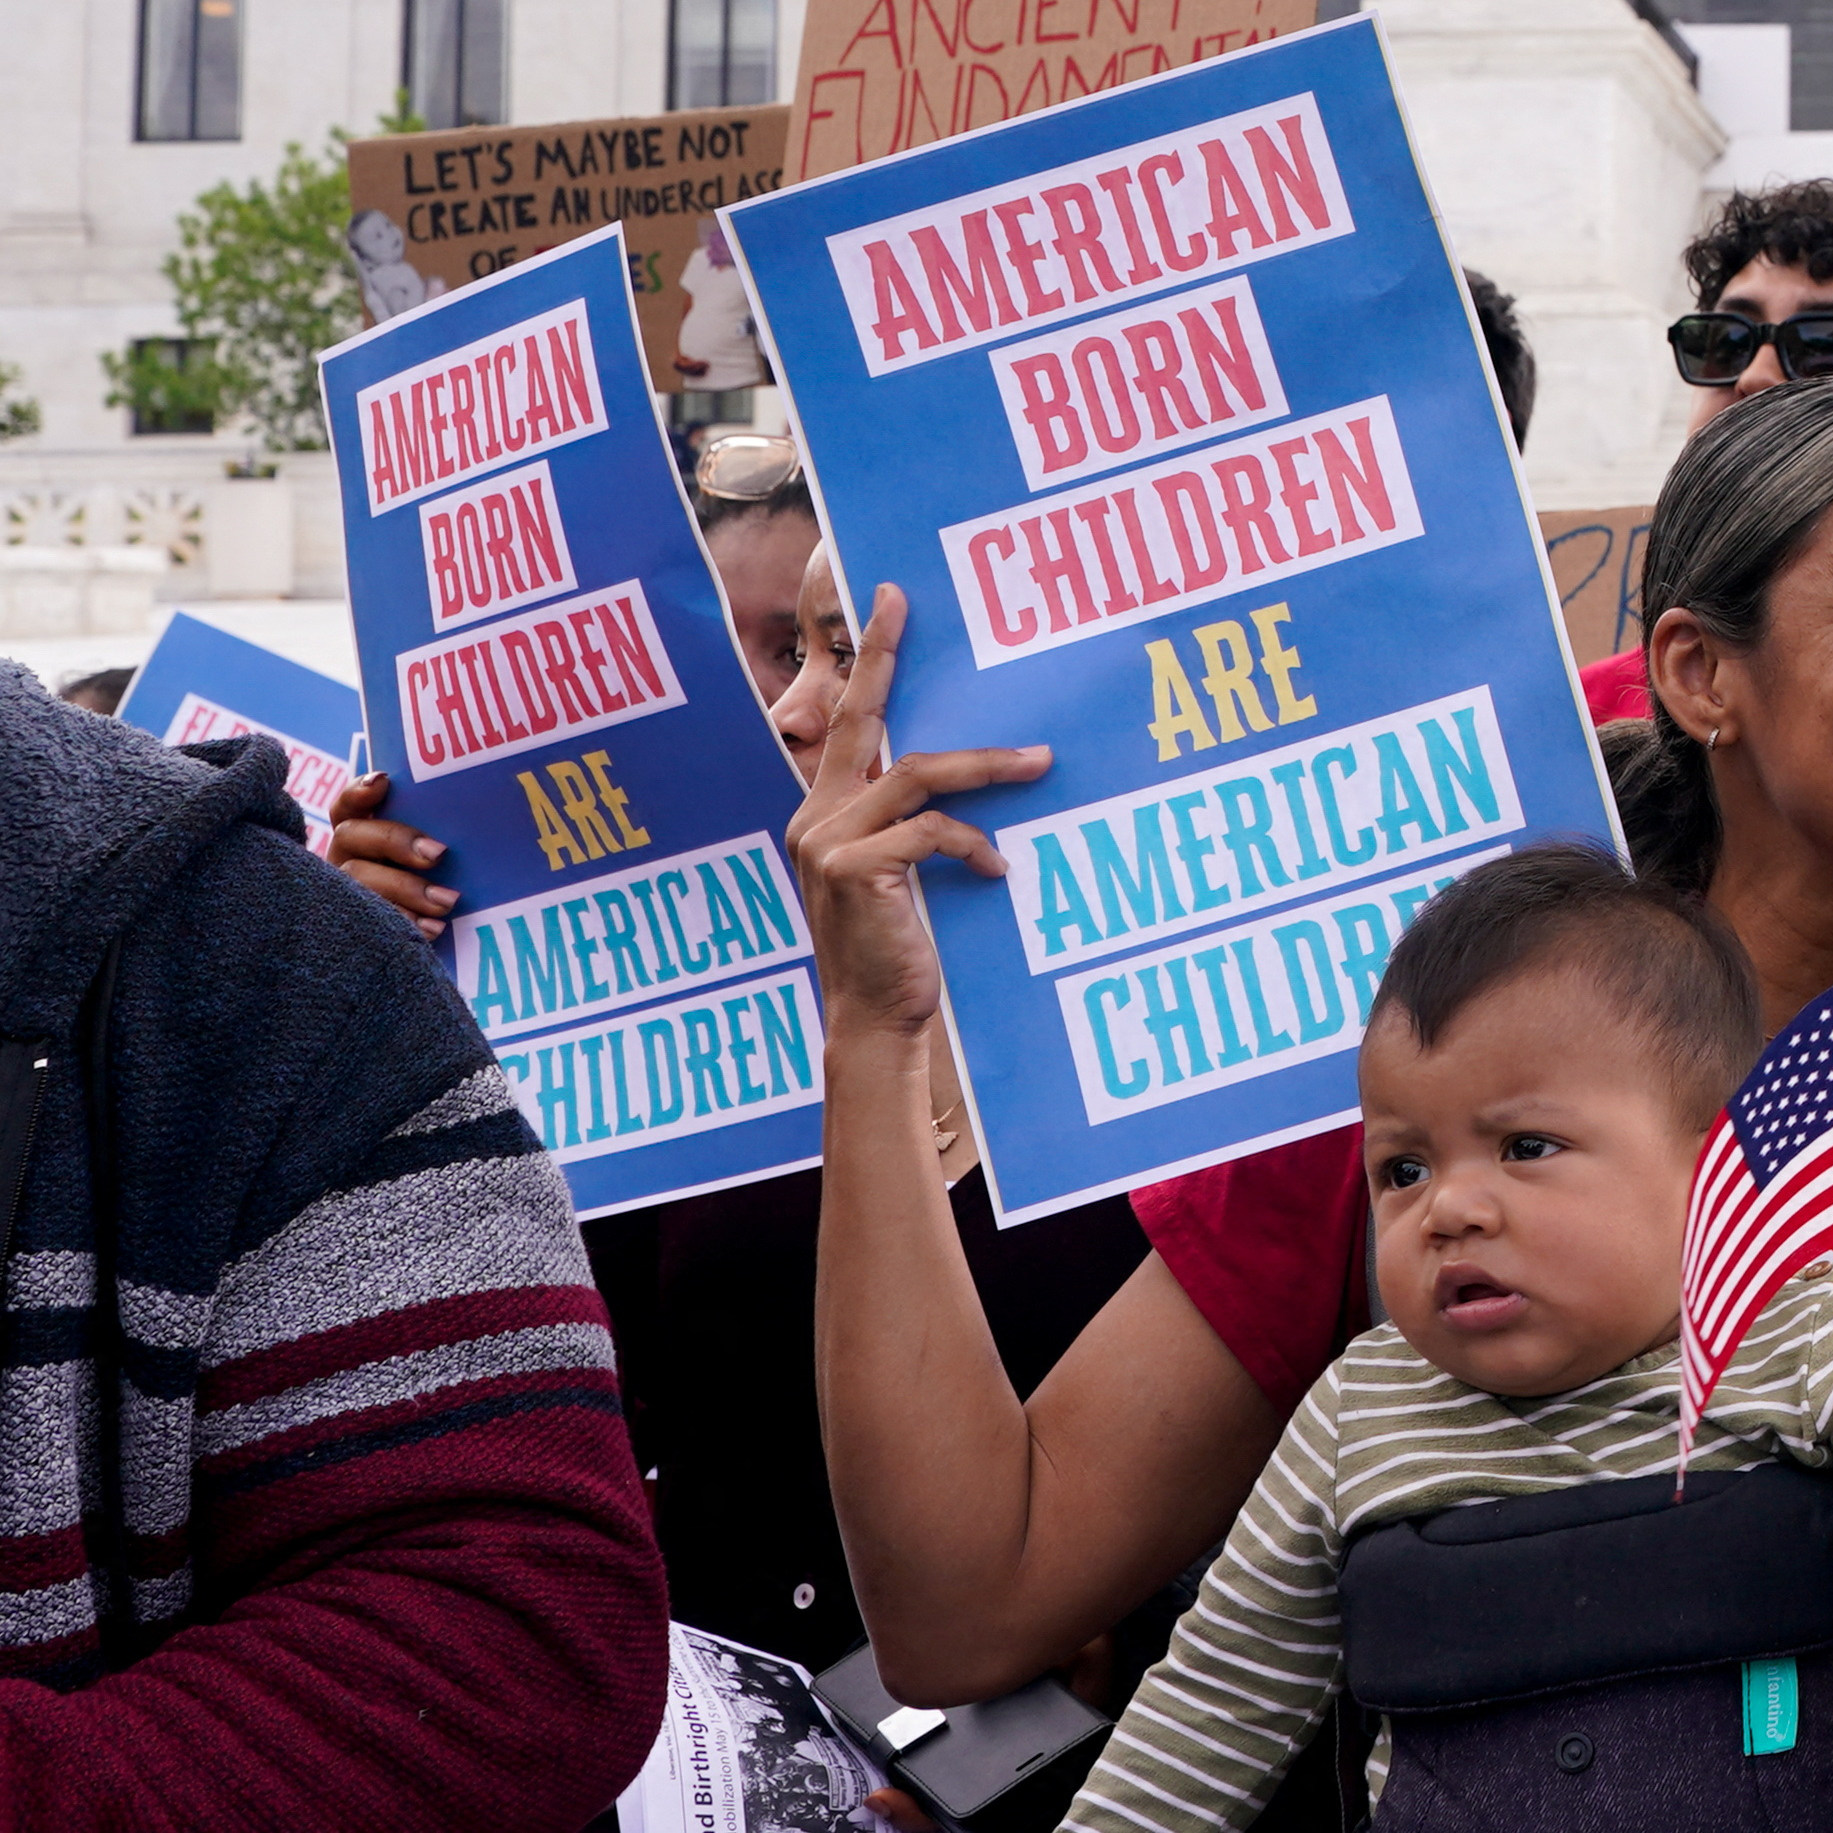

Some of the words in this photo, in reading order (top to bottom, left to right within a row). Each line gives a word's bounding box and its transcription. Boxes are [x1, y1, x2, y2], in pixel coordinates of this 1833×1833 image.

[404, 141, 514, 196] LET'S
[534, 126, 665, 181] MAYBE
[678, 121, 750, 162] NOT
[407, 193, 538, 244] CREATE
[550, 186, 592, 226] AN
[863, 114, 1332, 361] AMERICAN
[370, 317, 594, 505] AMERICAN
[1010, 295, 1267, 474] BORN
[428, 478, 563, 619] BORN
[967, 416, 1397, 648] CHILDREN
[406, 596, 668, 767] CHILDREN
[1142, 602, 1318, 763] ARE
[516, 749, 651, 871] ARE
[1031, 706, 1501, 957] AMERICAN
[470, 846, 797, 1030] AMERICAN
[1083, 877, 1457, 1100] CHILDR
[683, 1703, 714, 1809] Birthright
[705, 1700, 717, 1711] to
[708, 1712, 722, 1724] 15
[714, 1727, 729, 1752] May
